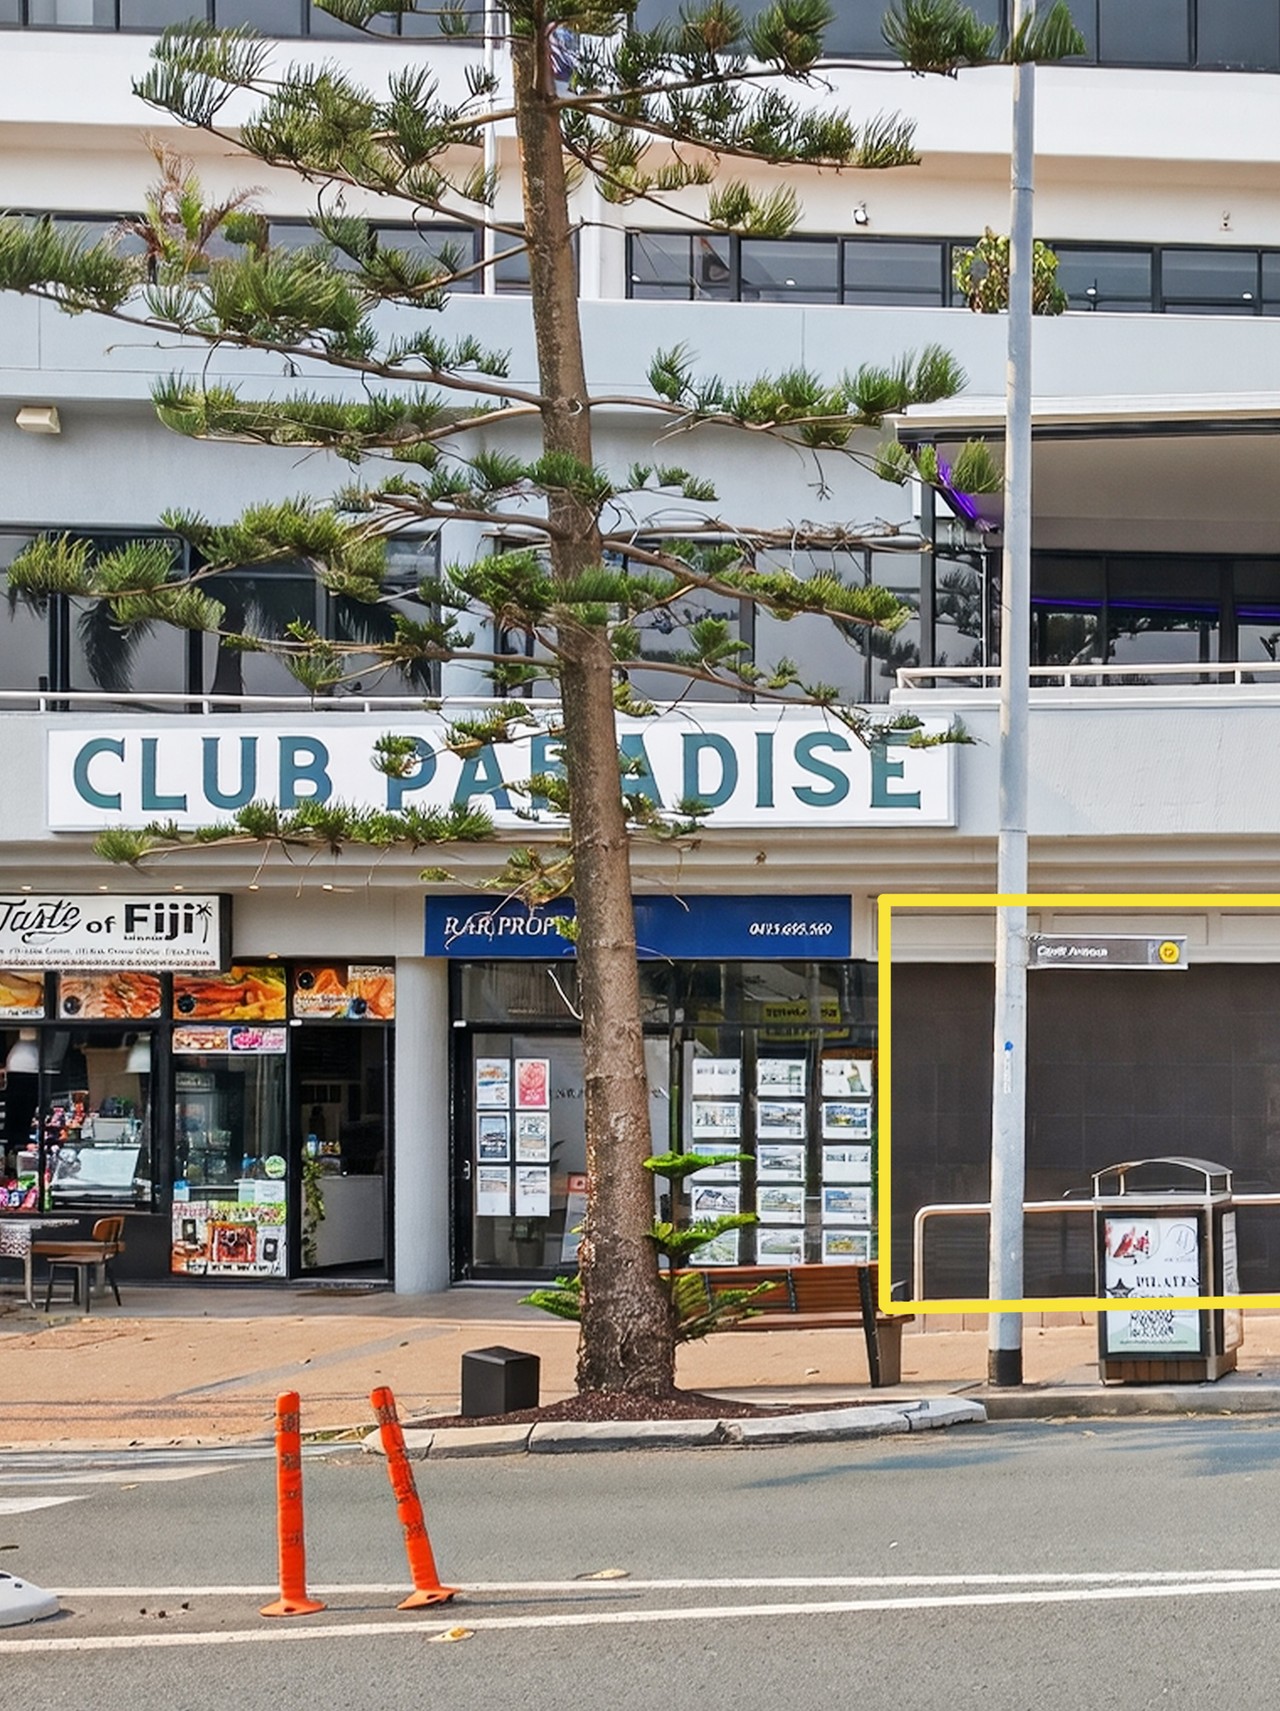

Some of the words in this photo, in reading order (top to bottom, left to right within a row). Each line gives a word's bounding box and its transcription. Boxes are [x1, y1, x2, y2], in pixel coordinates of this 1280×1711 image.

[73, 737, 333, 812] CLUB
[86, 916, 117, 933] of
[124, 902, 195, 940] Fiji
